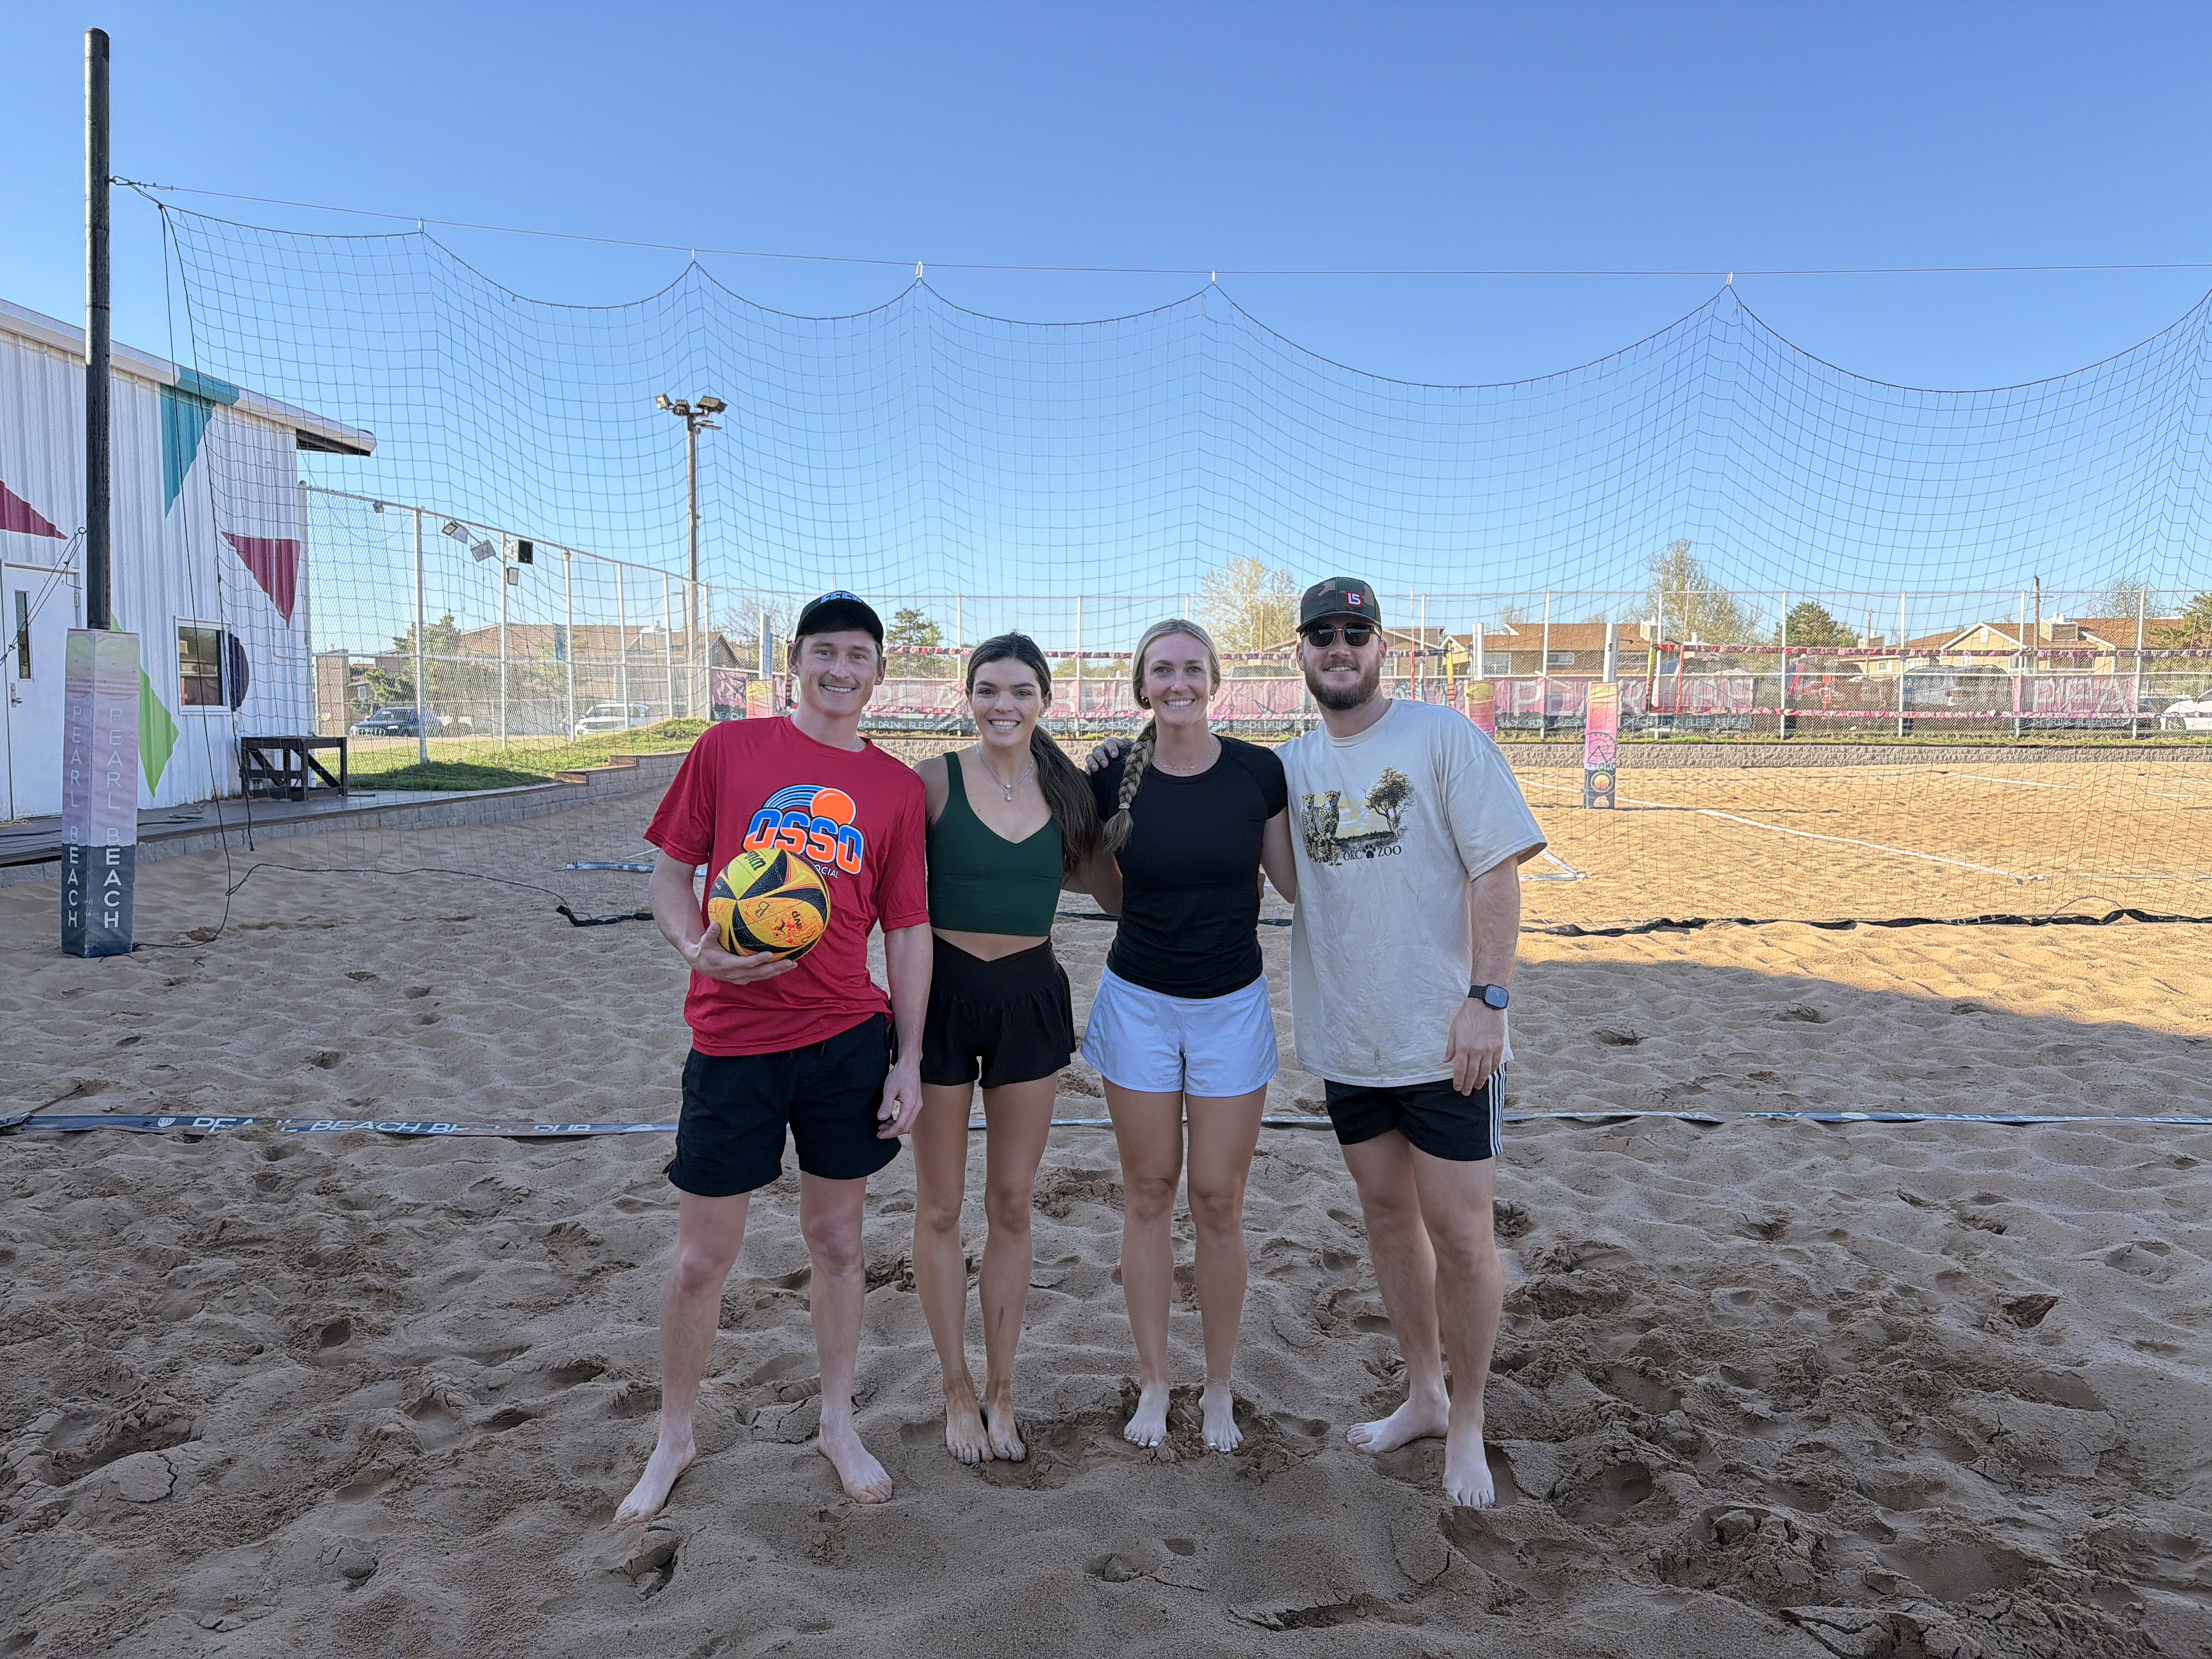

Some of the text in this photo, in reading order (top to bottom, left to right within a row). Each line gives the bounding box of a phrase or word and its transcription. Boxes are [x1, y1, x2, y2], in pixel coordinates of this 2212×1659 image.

[67, 706, 83, 928] PEARL BEACH
[103, 708, 123, 929] PEARL BEACH
[743, 809, 864, 874] OSSO
[1343, 845, 1402, 861] OKC ZOO
[309, 1120, 422, 1132] BEACH
